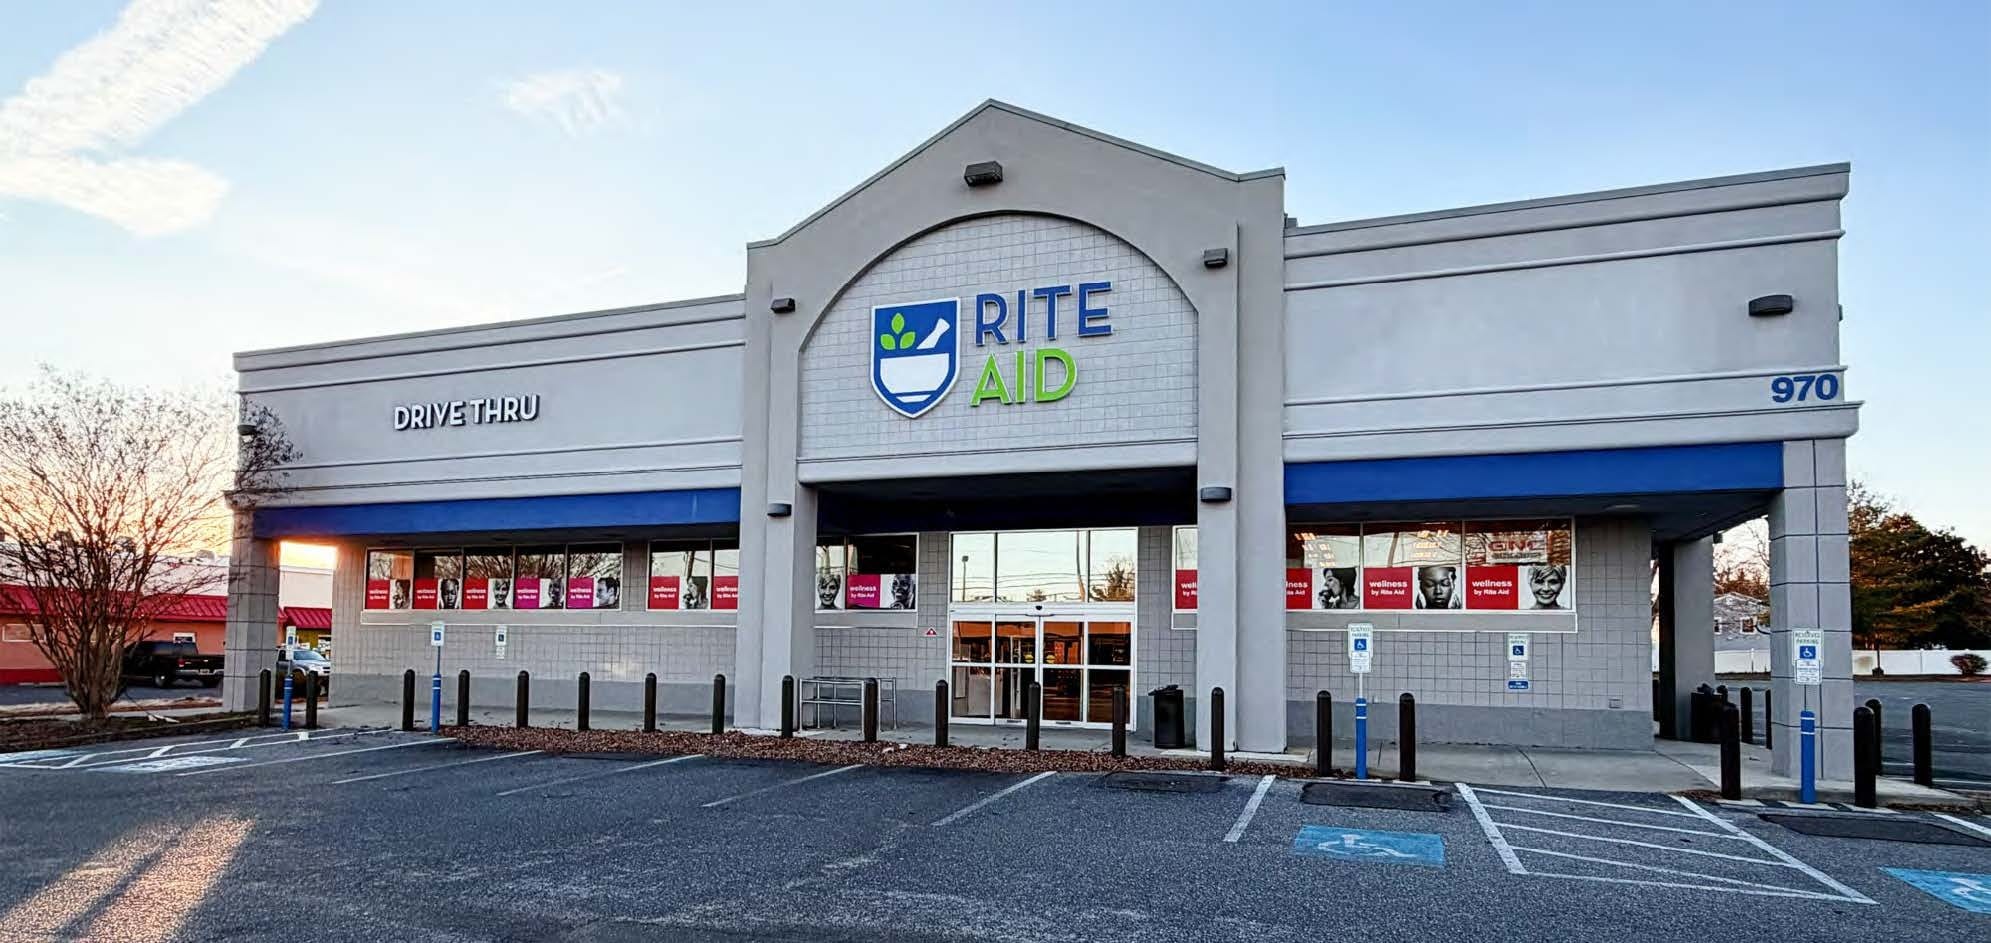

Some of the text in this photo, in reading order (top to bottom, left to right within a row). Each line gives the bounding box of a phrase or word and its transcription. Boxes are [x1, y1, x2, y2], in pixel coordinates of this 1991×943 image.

[975, 281, 1112, 346] RITE
[970, 348, 1077, 407] AID
[1772, 374, 1838, 402] 970
[394, 394, 540, 431] DRIVE THRU
[1369, 580, 1408, 588] wellness
[1474, 588, 1482, 596] by
